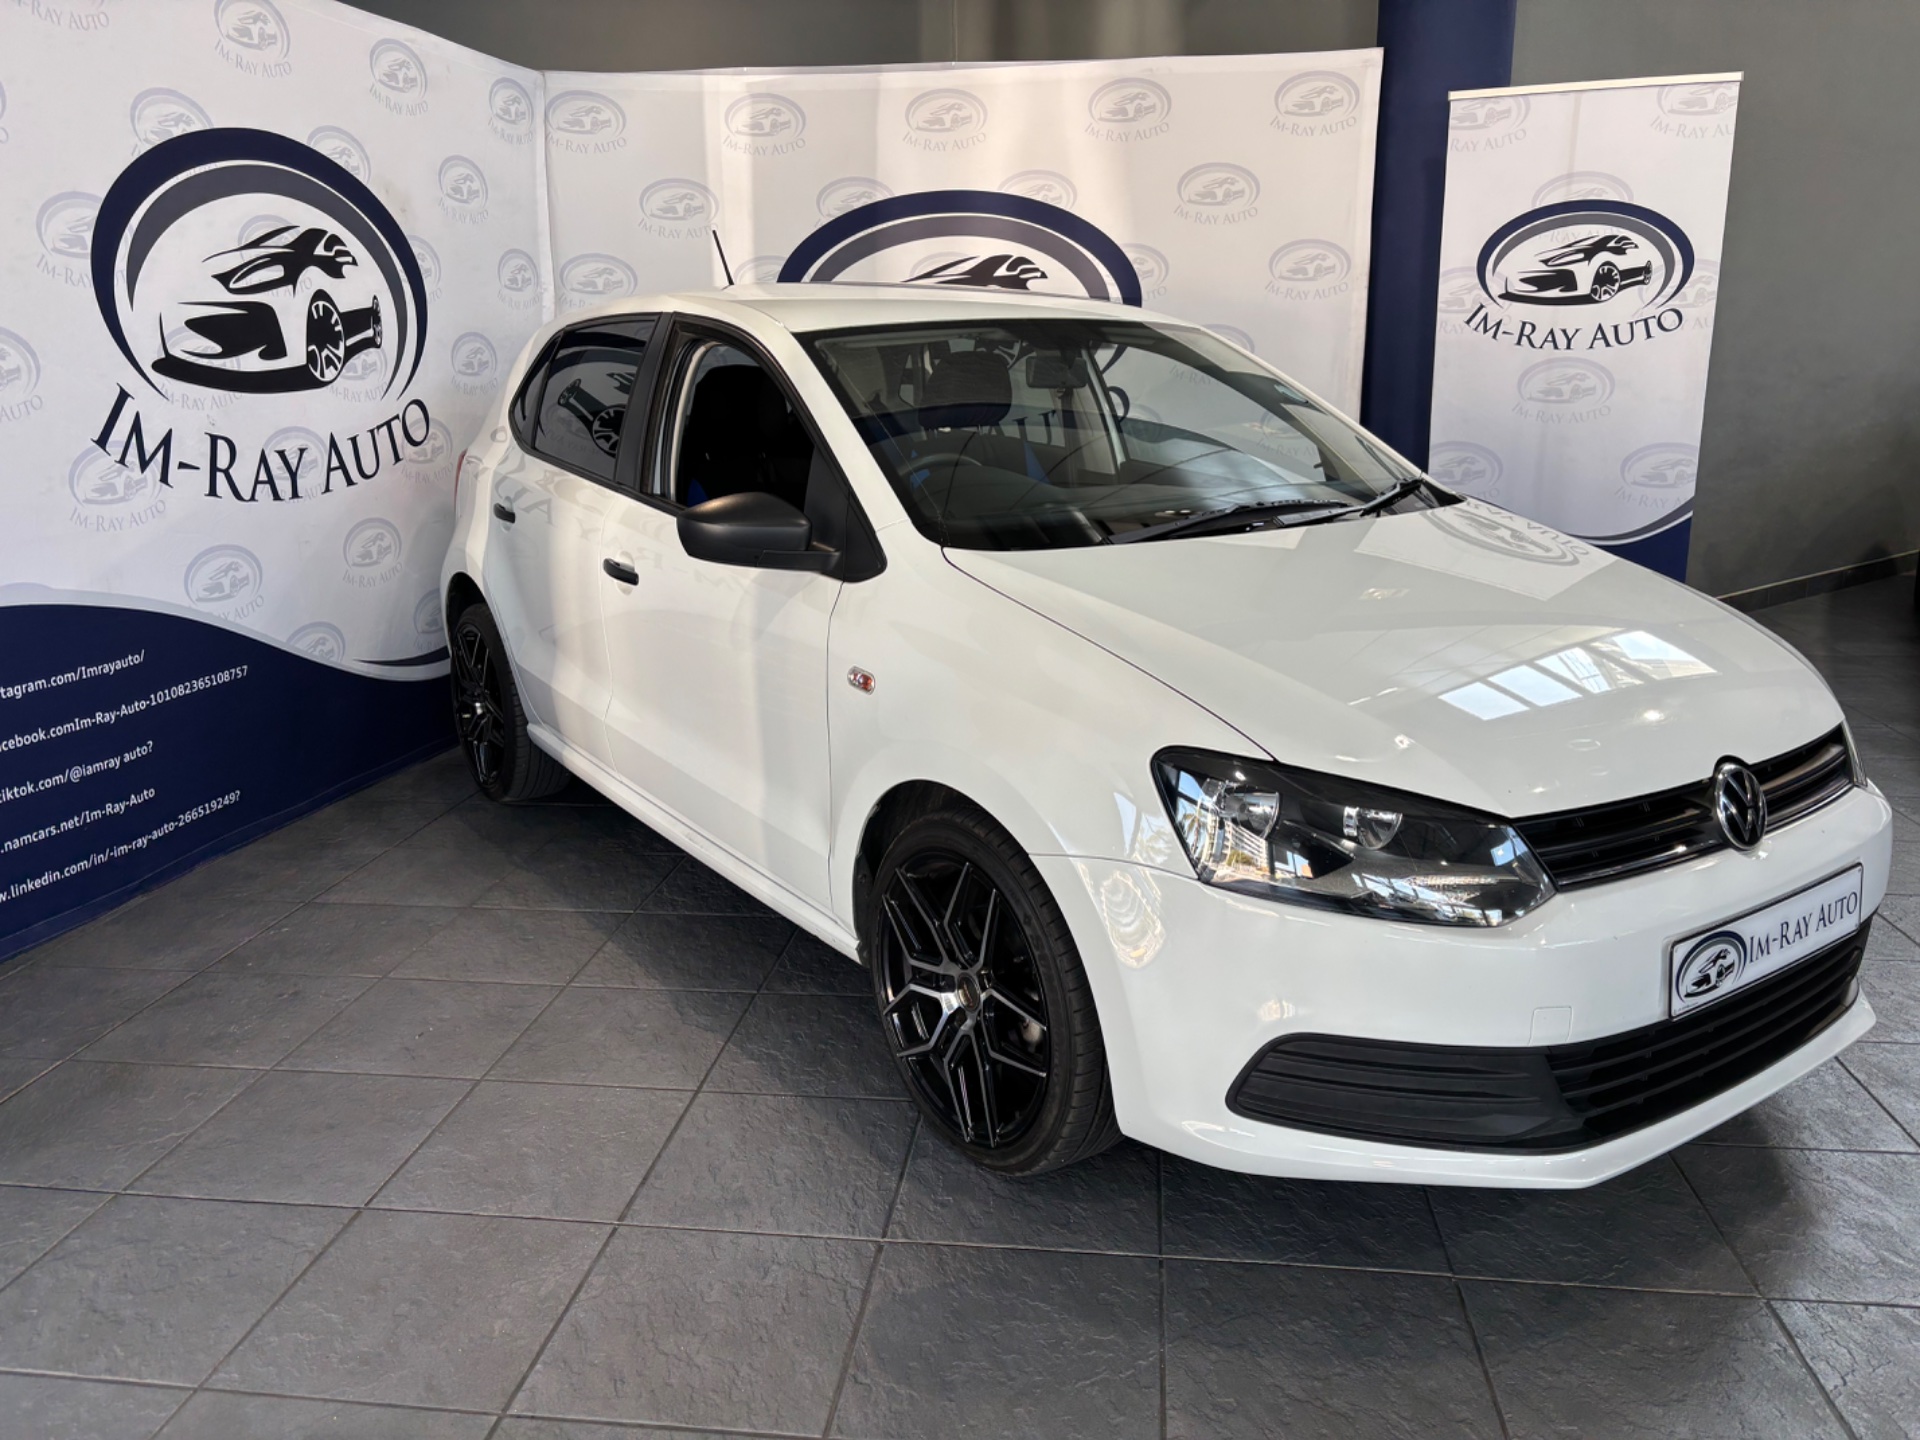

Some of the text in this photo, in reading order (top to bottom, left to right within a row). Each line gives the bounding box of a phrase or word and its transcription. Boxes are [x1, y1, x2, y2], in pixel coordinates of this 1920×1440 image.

[262, 61, 292, 78] AUTO
[1134, 121, 1170, 141] AUTO
[1320, 116, 1357, 137] AUTO
[593, 136, 627, 154] AUTO
[770, 137, 806, 156] AUTO
[952, 132, 987, 152] AUTO
[1482, 128, 1528, 152] AUTO
[1222, 206, 1259, 225] AUTO
[1313, 281, 1349, 300] AUTO
[1463, 303, 1582, 350] IM-RAY
[1586, 308, 1683, 350] AUTO
[90, 383, 309, 503] IM-RAY
[321, 398, 431, 495] AUTO
[128, 500, 166, 529] AUTO
[123, 740, 153, 763] auto?
[1749, 891, 1858, 964] IM-RAY AUTO
